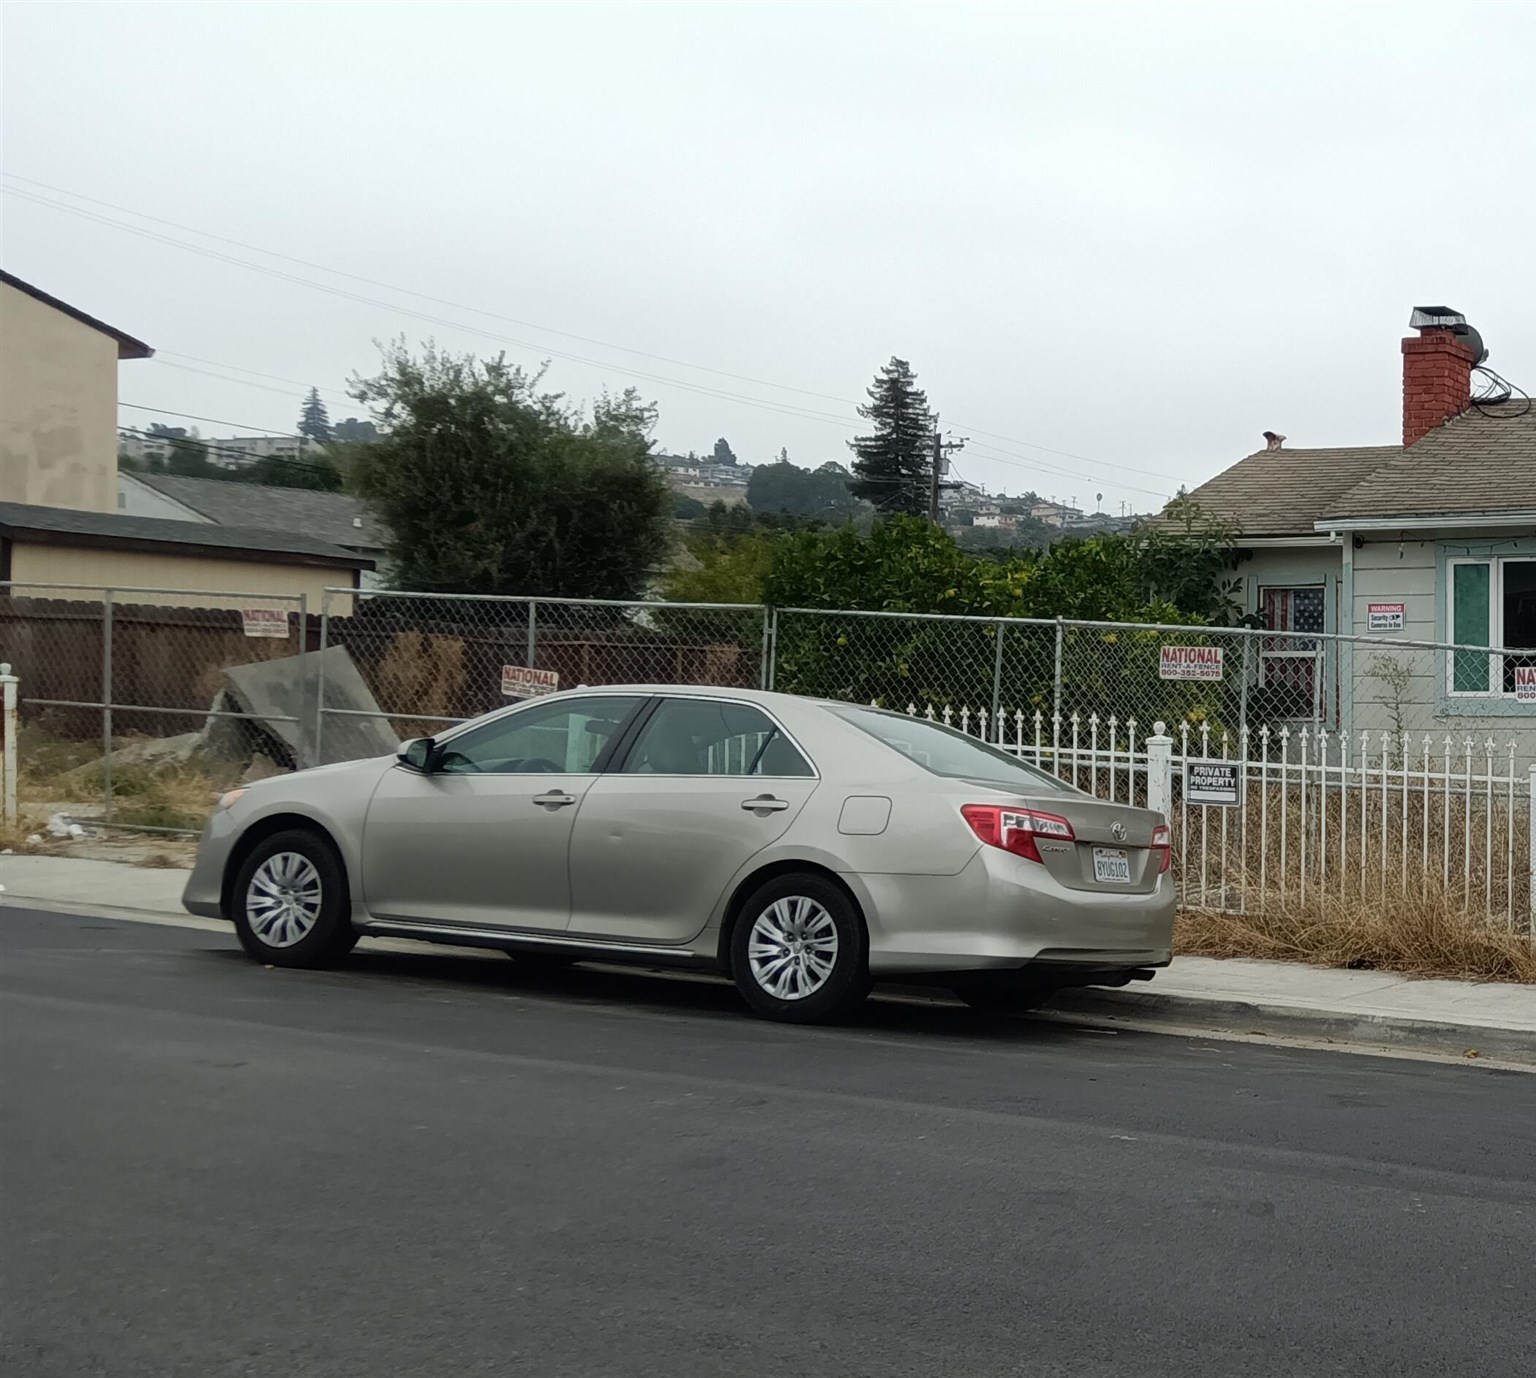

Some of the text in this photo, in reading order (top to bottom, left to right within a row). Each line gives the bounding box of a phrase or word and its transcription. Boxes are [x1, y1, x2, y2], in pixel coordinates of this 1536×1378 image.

[1162, 647, 1221, 664] NATIONAL
[504, 666, 556, 687] NATIONAL
[1193, 766, 1232, 777] PRIVATE
[1190, 776, 1236, 787] PROPERTY
[1096, 860, 1129, 879] 8YUG102
